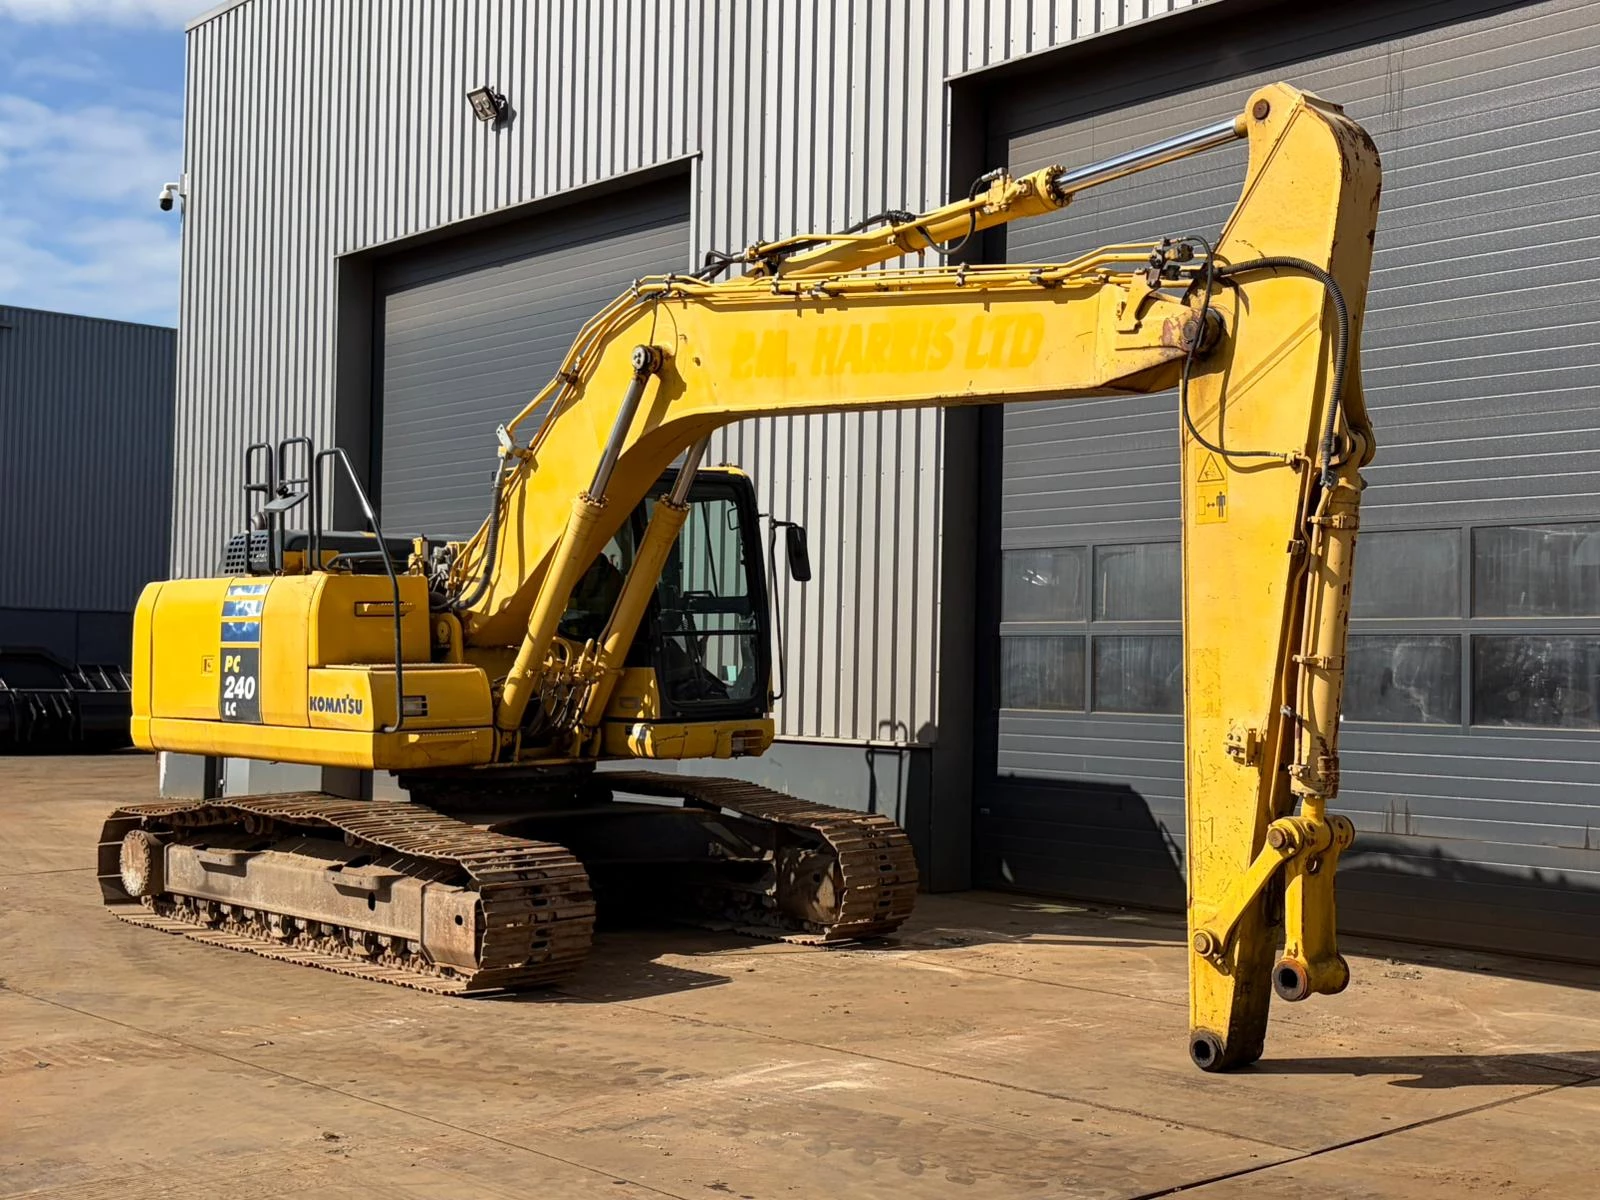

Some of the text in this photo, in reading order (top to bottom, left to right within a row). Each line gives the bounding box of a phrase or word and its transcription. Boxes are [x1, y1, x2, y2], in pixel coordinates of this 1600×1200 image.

[964, 312, 1045, 370] LTD
[224, 655, 241, 673] PC
[224, 676, 256, 700] 240
[225, 702, 237, 716] LC
[309, 694, 363, 715] KOMATSU
